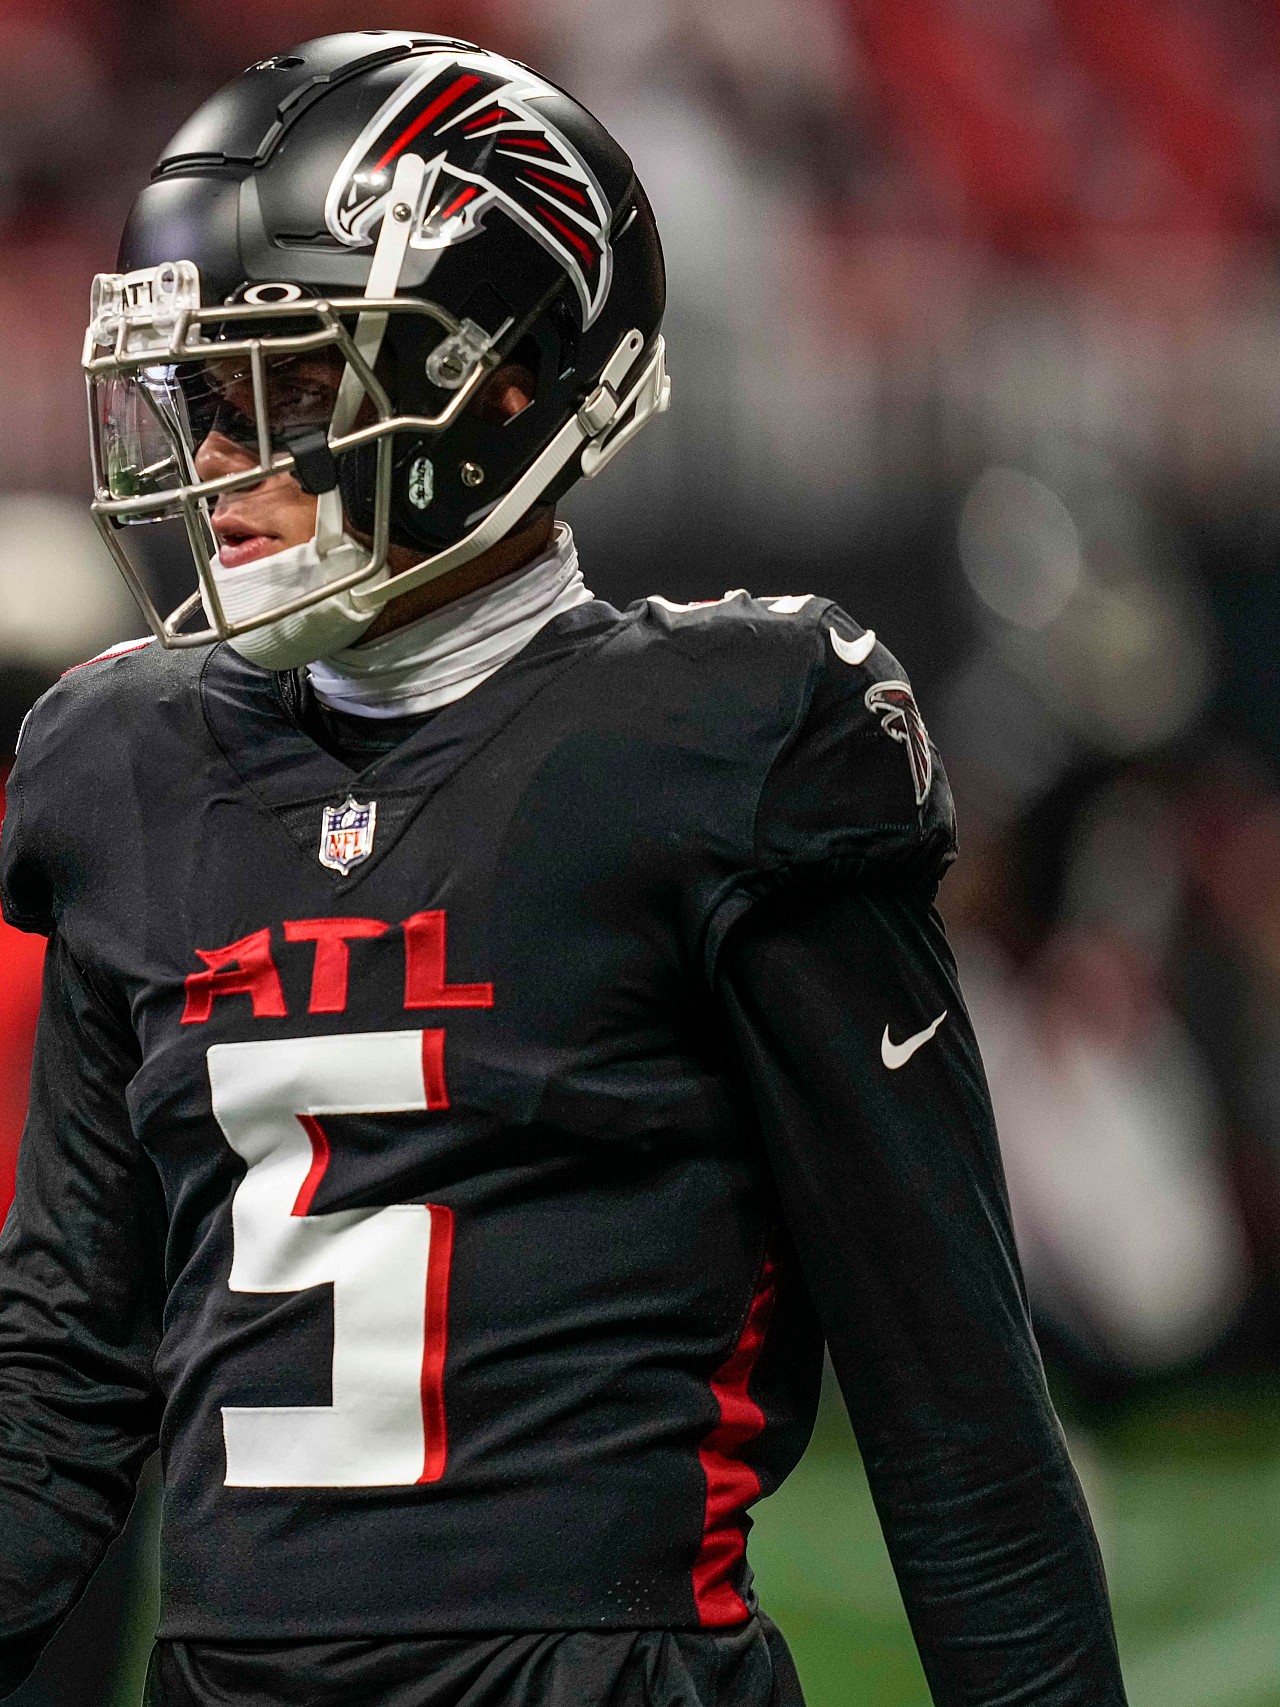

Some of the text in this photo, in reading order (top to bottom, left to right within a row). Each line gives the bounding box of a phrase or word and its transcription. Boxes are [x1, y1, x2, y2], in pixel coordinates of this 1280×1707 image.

[328, 831, 362, 859] NFL
[180, 910, 494, 1023] ATL
[207, 1029, 454, 1486] 5
